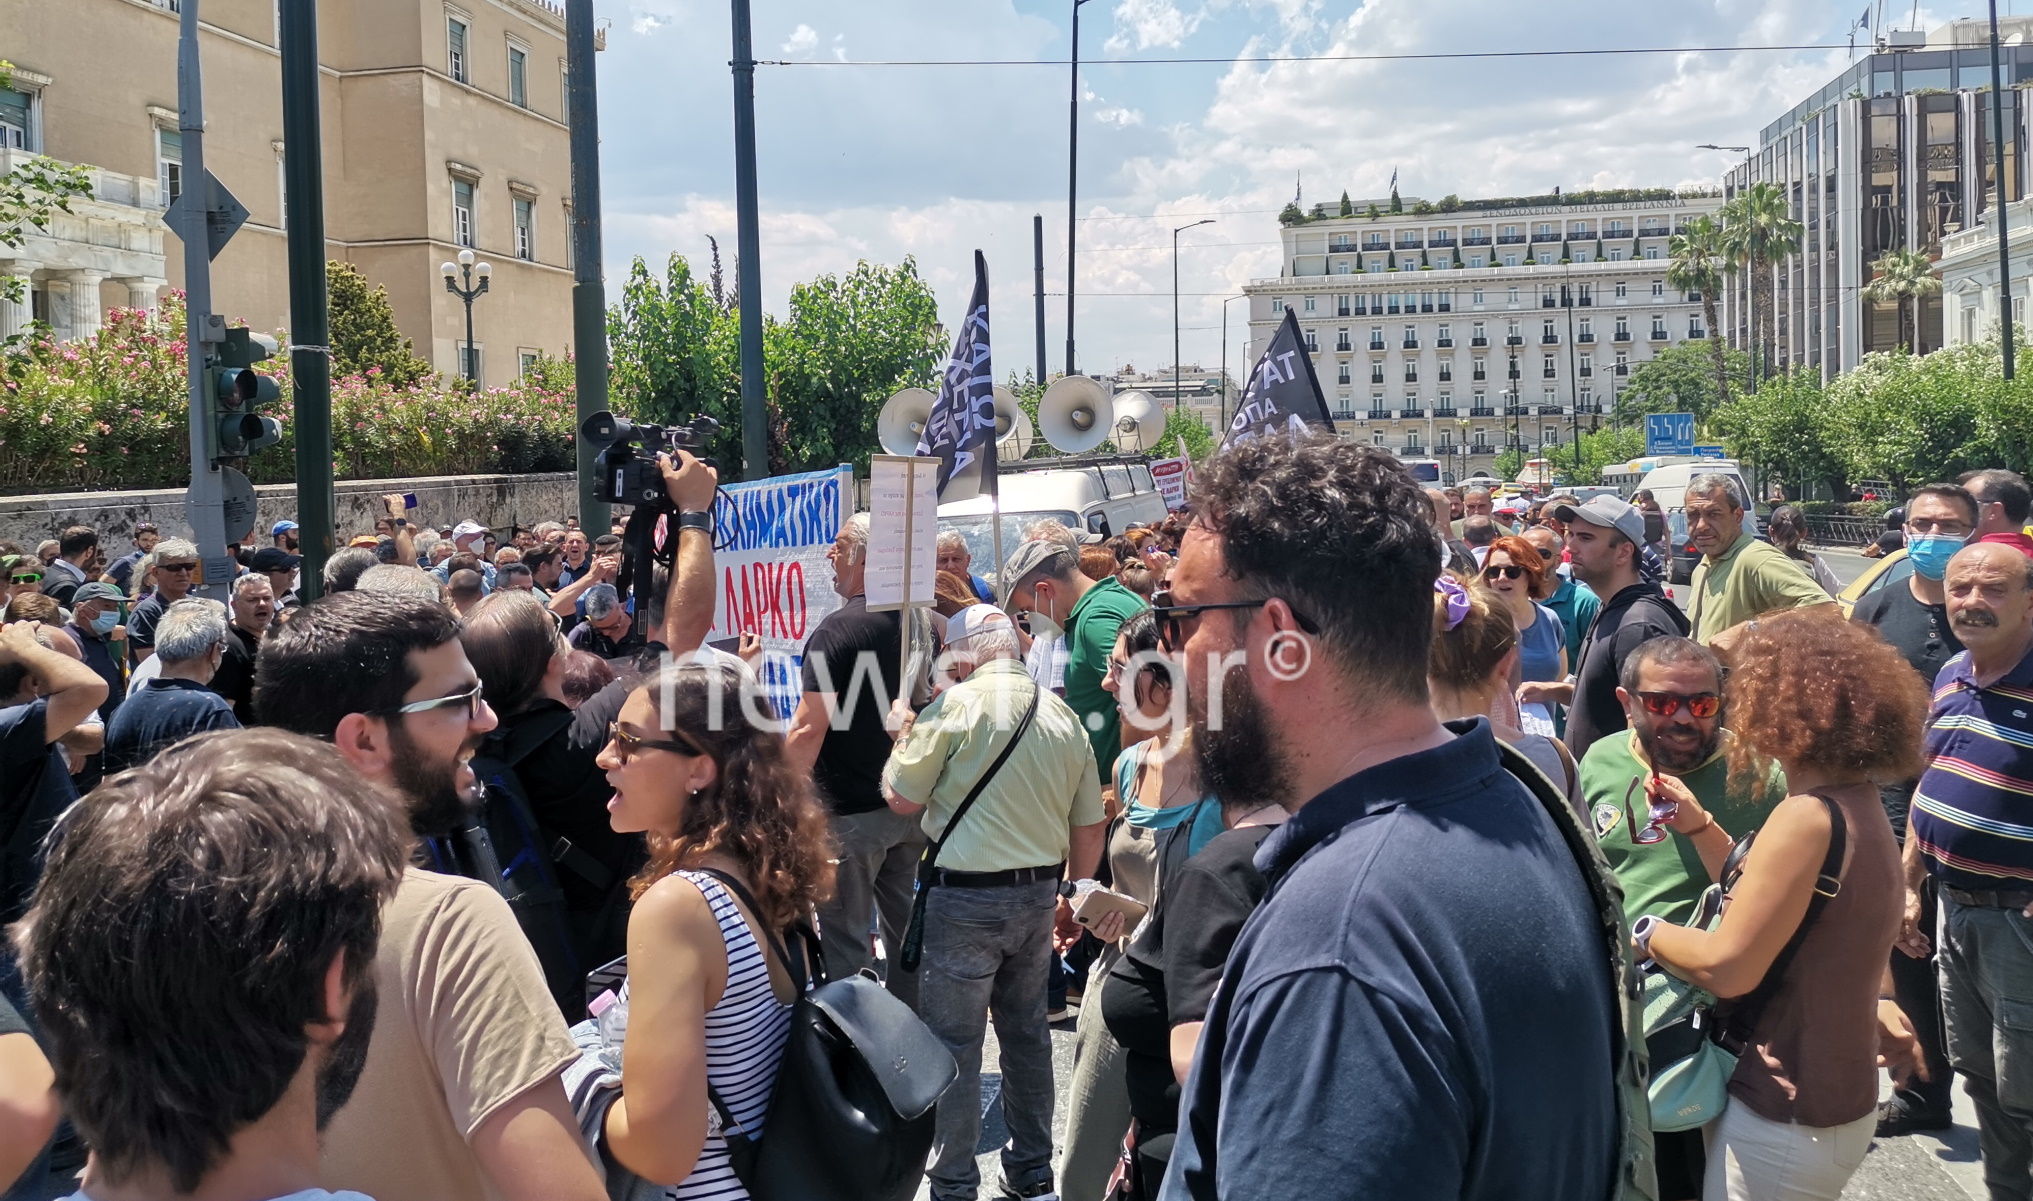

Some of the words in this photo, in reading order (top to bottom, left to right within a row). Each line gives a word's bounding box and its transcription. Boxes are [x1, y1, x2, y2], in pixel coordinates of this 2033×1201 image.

[1568, 203, 1615, 213] ΜΕΓΑΛΗ
[1622, 199, 1687, 211] ΒΡΕΤΑΝΝΙΑ
[714, 478, 839, 552] ΚΛΗΜΑΤΙΚΟ
[725, 560, 807, 641] ΛΑΡΚΟ
